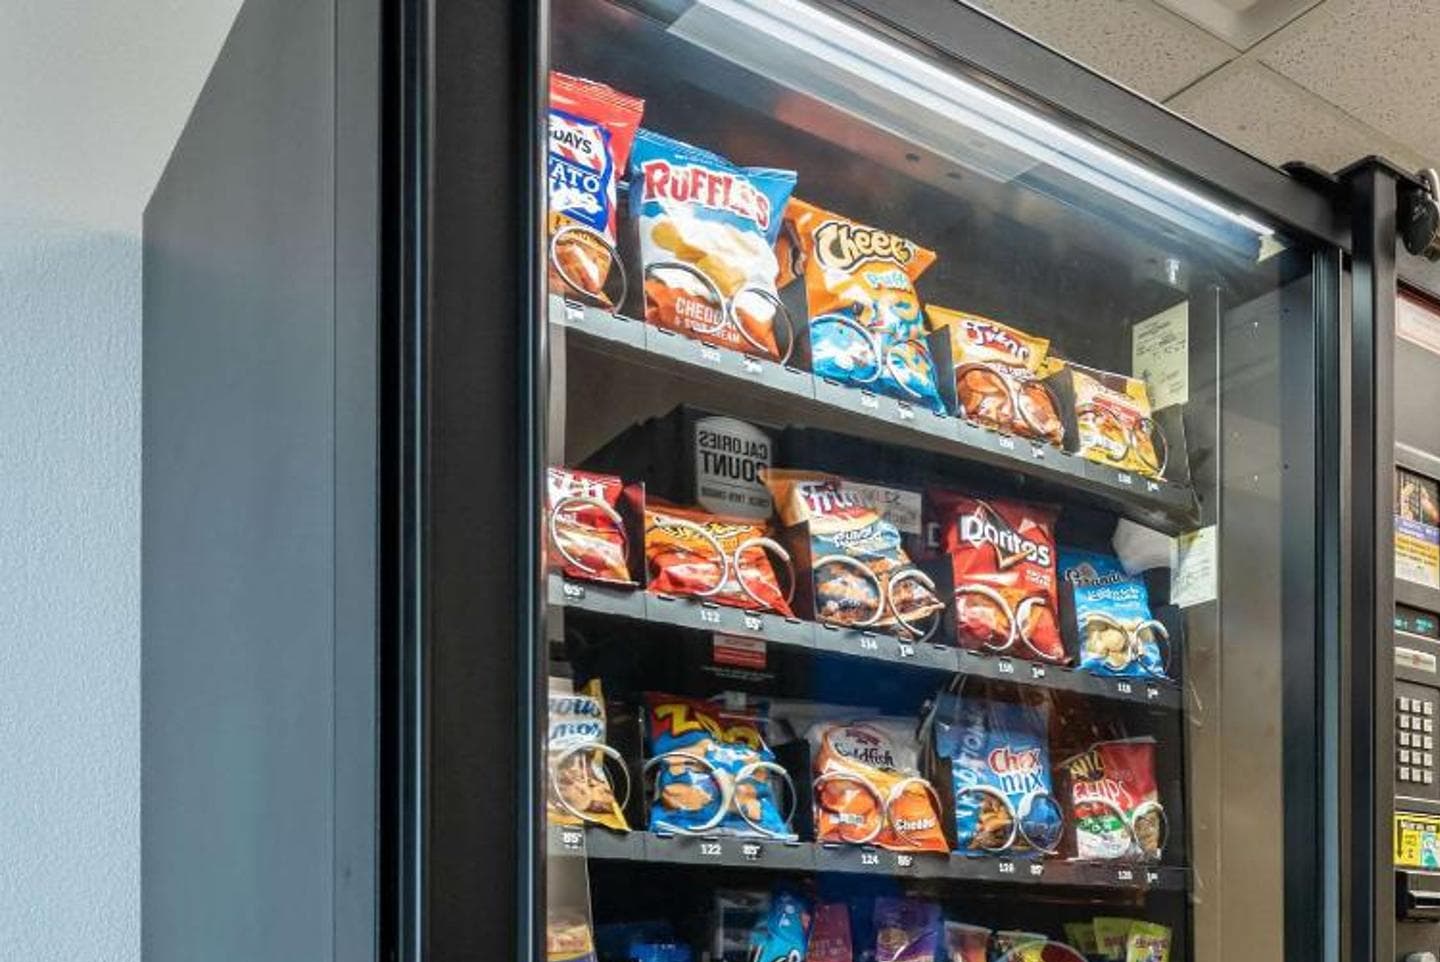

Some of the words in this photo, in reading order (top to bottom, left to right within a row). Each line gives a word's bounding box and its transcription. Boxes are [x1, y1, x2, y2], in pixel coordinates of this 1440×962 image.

[642, 160, 770, 228] RUFFLES
[960, 514, 1050, 567] Doritos
[833, 740, 895, 769] Gldfish
[700, 844, 722, 855] 122
[861, 854, 880, 865] 124
